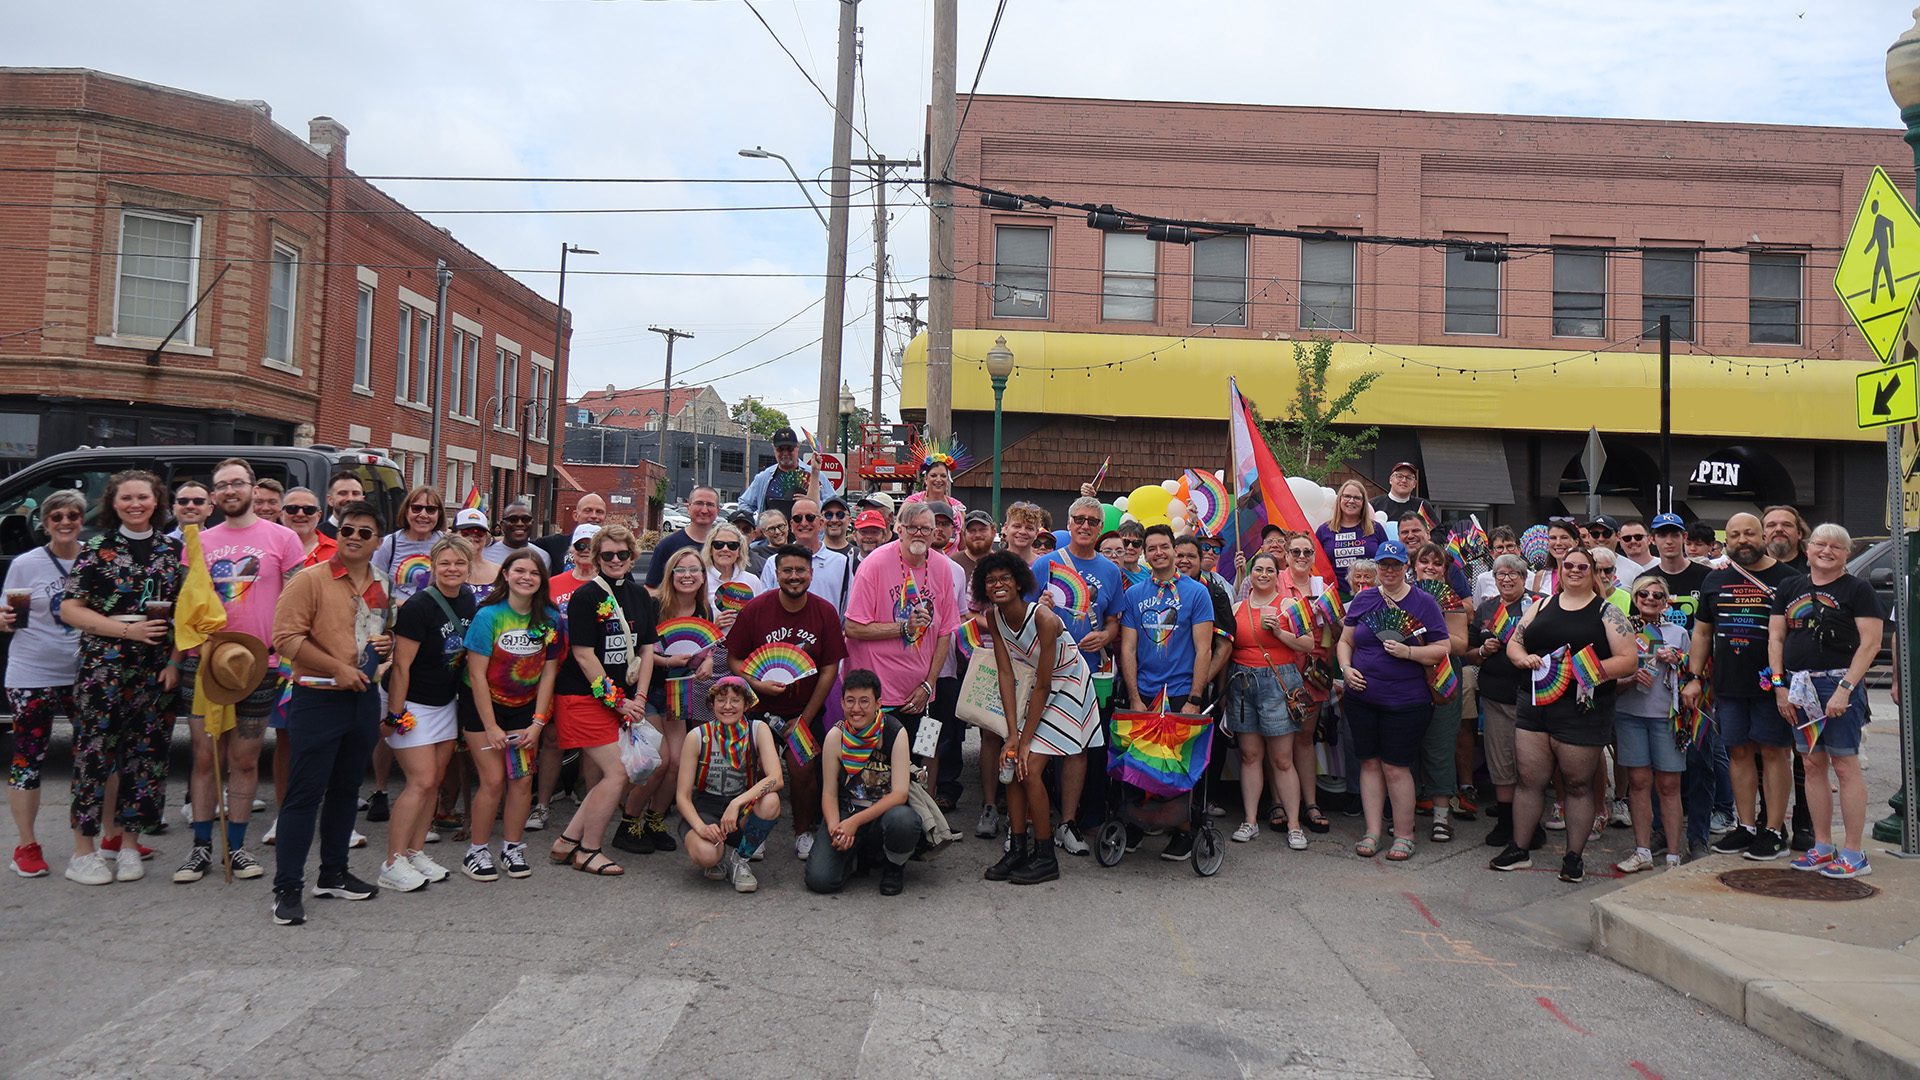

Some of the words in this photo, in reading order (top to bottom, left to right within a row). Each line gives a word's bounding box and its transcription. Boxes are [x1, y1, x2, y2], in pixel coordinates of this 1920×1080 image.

[824, 462, 839, 470] NOT
[1690, 460, 1740, 486] PEN
[1334, 540, 1366, 548] BISHOP
[1384, 543, 1397, 554] KC
[208, 545, 240, 563] PRIDE
[242, 545, 267, 559] 2026
[1335, 548, 1364, 557] LOVES
[1085, 573, 1103, 590] 2026
[1164, 597, 1183, 610] 2026
[609, 635, 636, 648] LOVS
[765, 626, 794, 644] PRIDE
[797, 628, 818, 645] 2026
